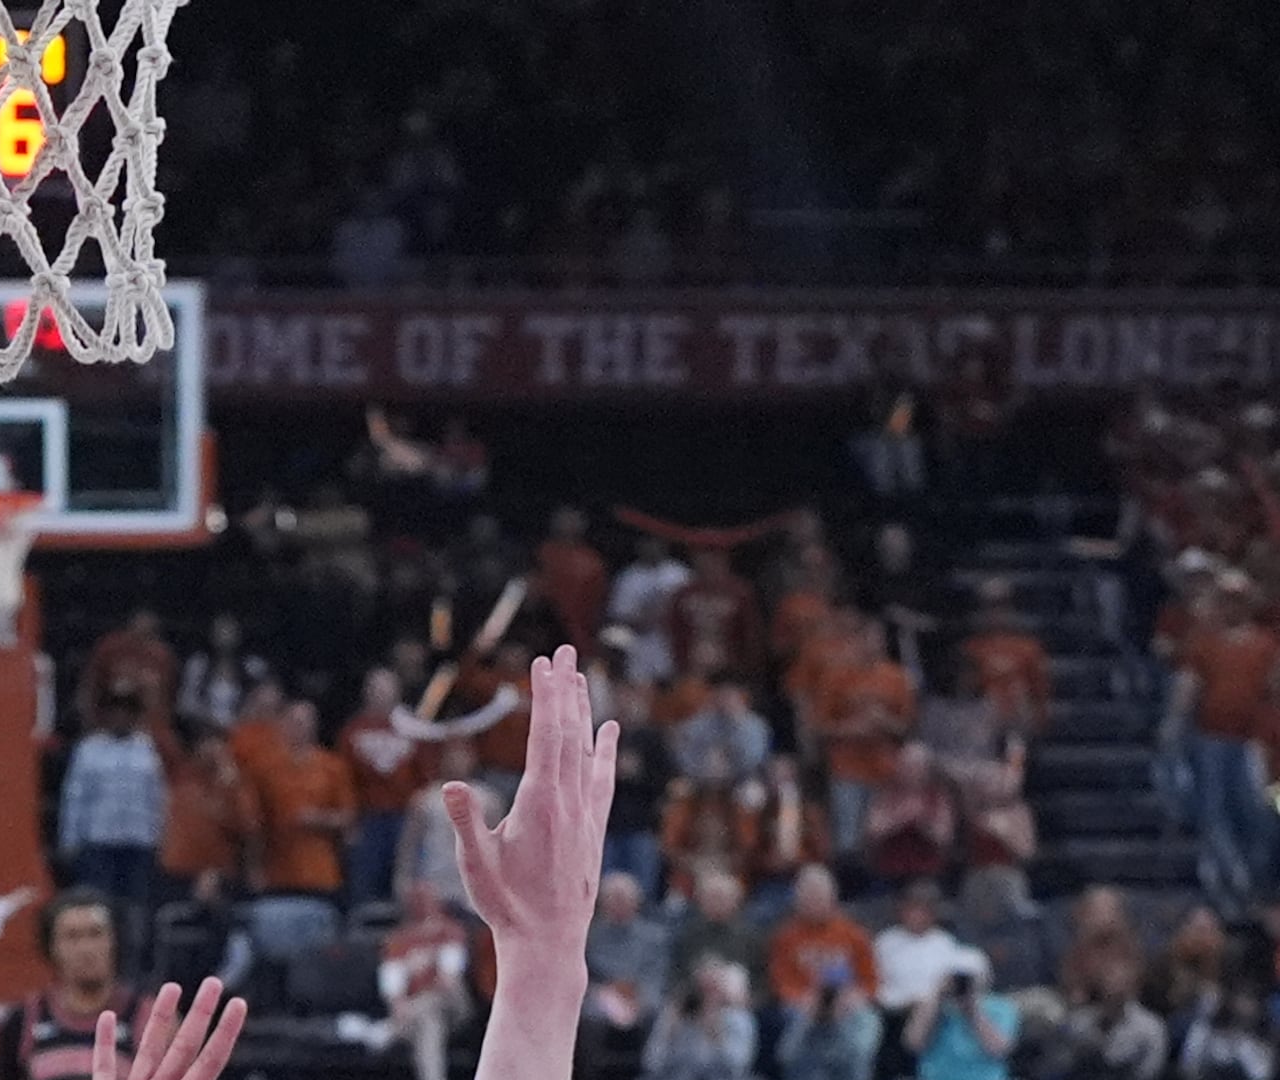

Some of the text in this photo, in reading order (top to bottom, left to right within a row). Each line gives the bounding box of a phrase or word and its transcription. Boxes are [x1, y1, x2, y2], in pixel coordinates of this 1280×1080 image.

[192, 312, 370, 386] OME
[395, 313, 502, 386] OF
[524, 313, 692, 386] THE
